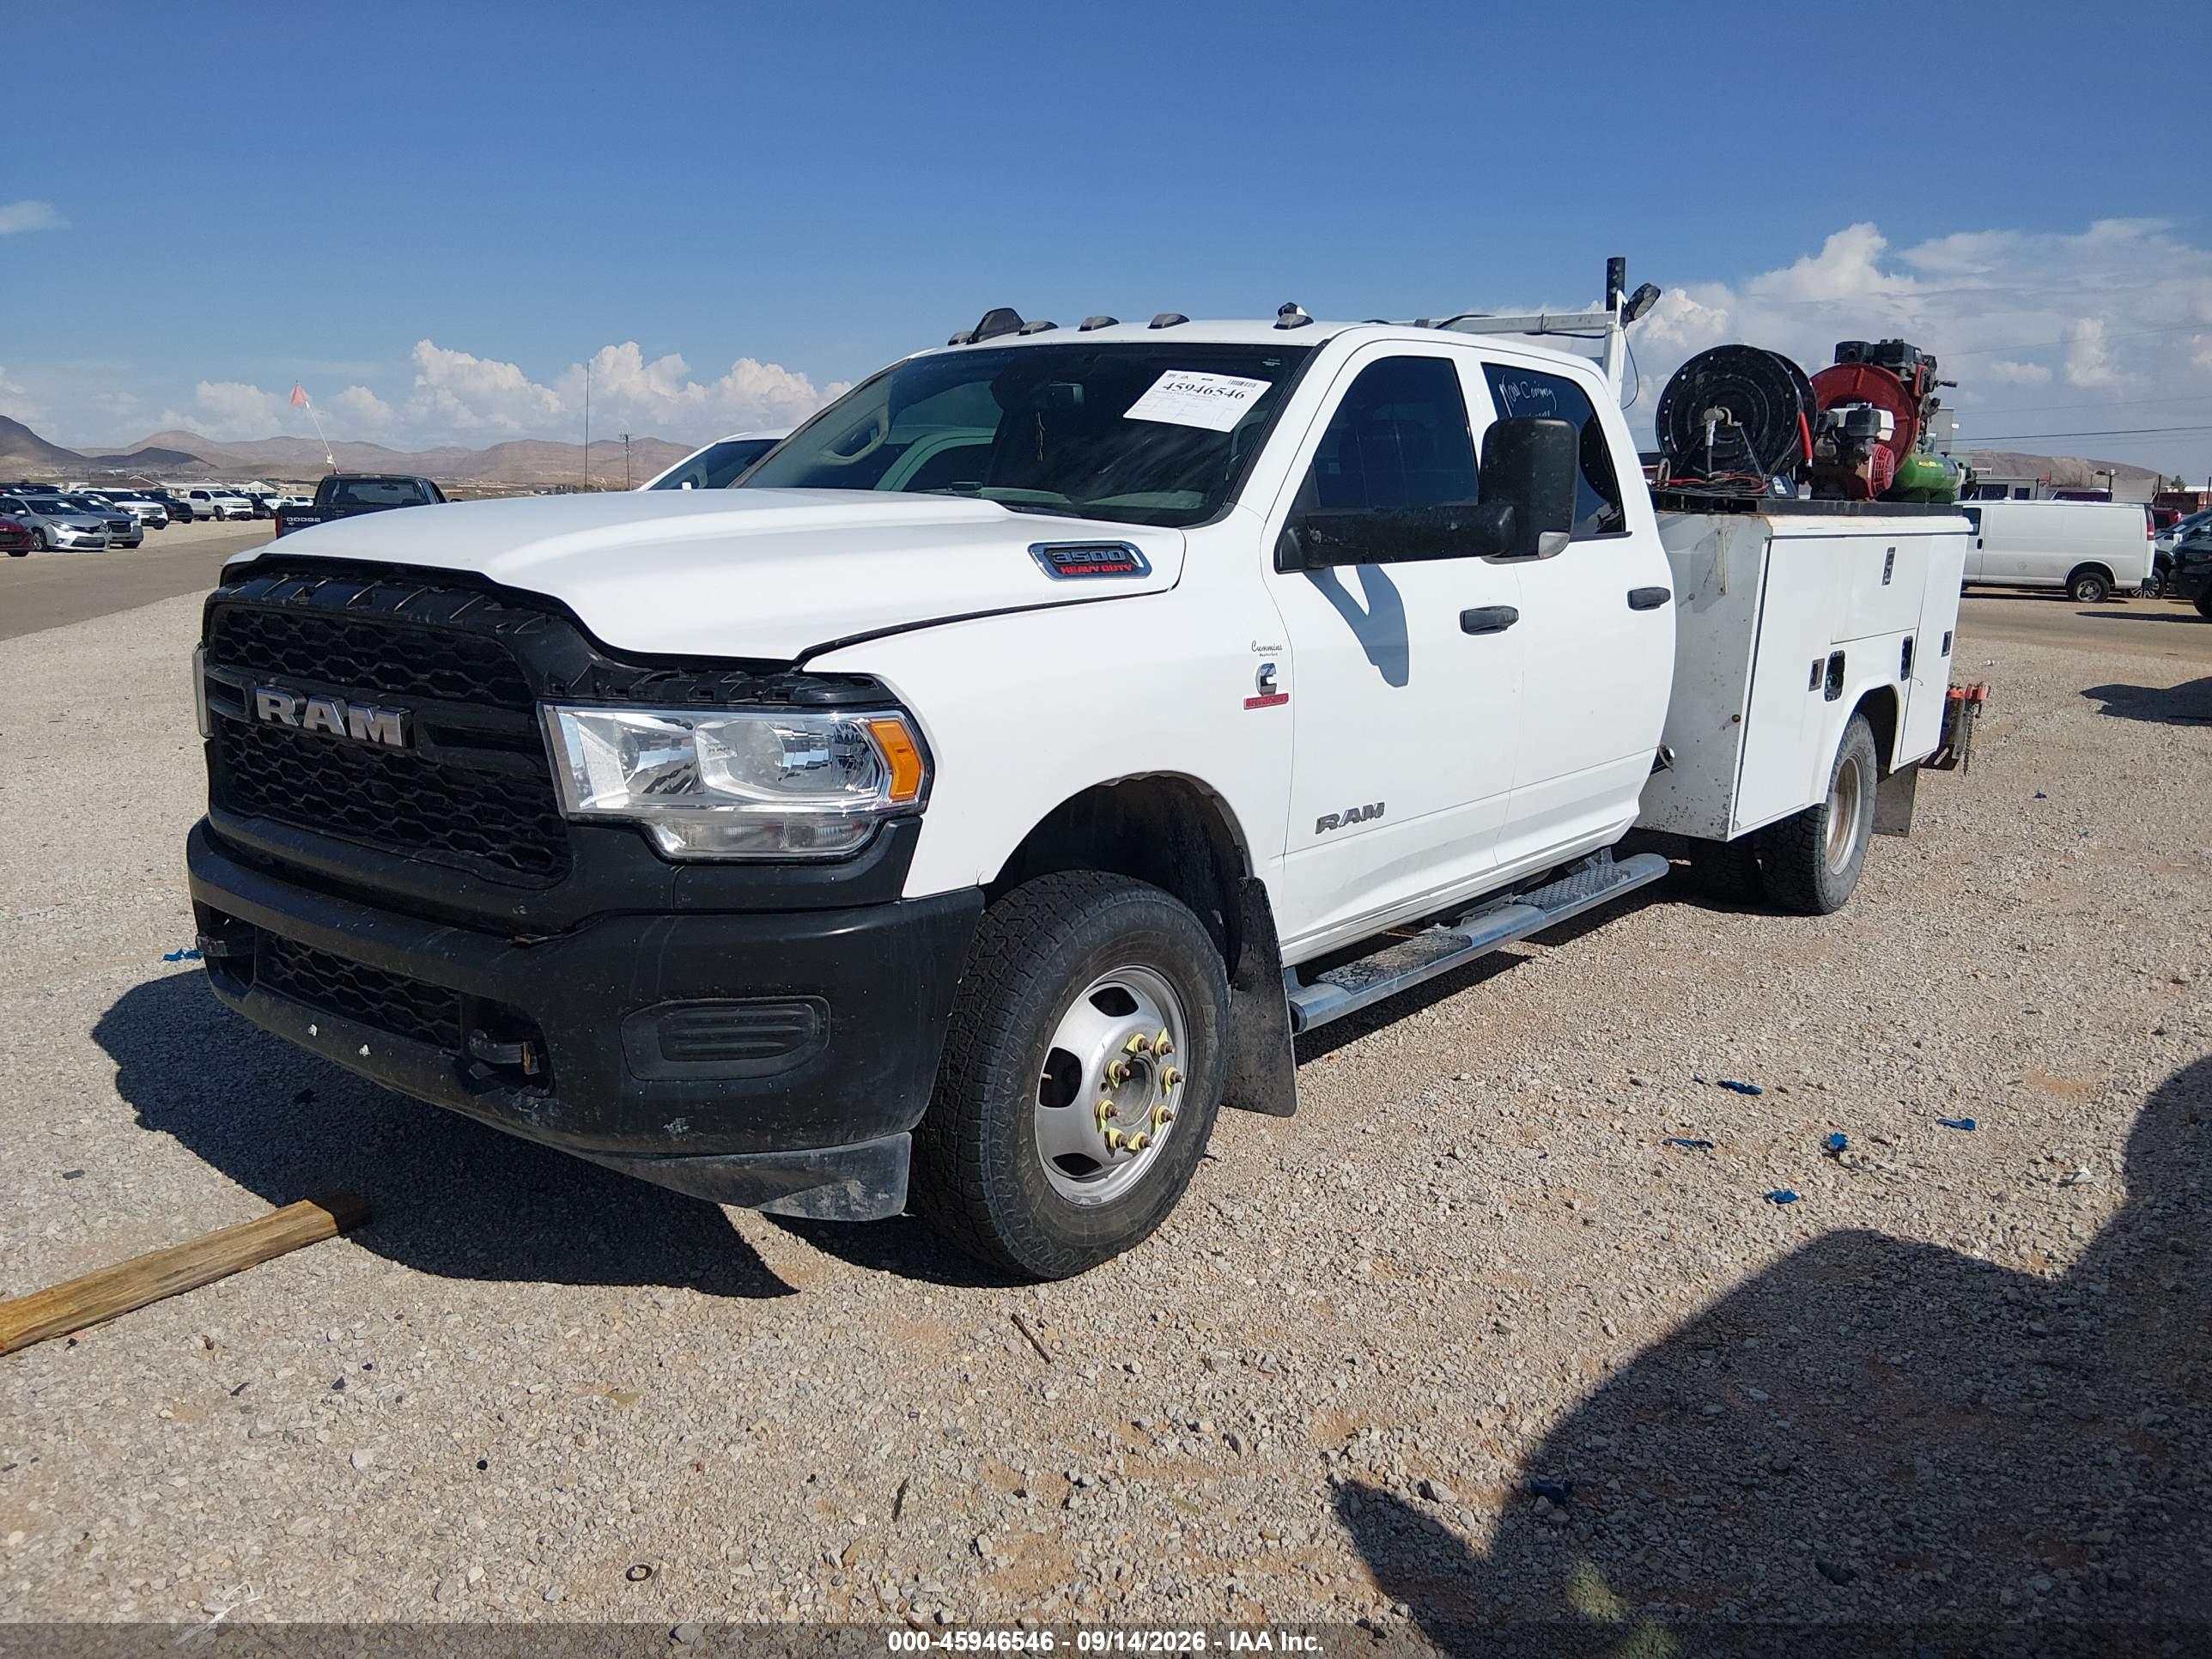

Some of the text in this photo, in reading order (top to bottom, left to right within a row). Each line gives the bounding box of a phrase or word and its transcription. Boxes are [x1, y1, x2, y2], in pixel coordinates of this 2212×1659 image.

[1163, 381, 1245, 400] 45946546
[1052, 550, 1126, 562] 3500
[1060, 563, 1133, 574] HEAVY DUTY
[1251, 640, 1283, 652] Cummins
[256, 686, 410, 747] RAM
[1315, 801, 1385, 835] RAM
